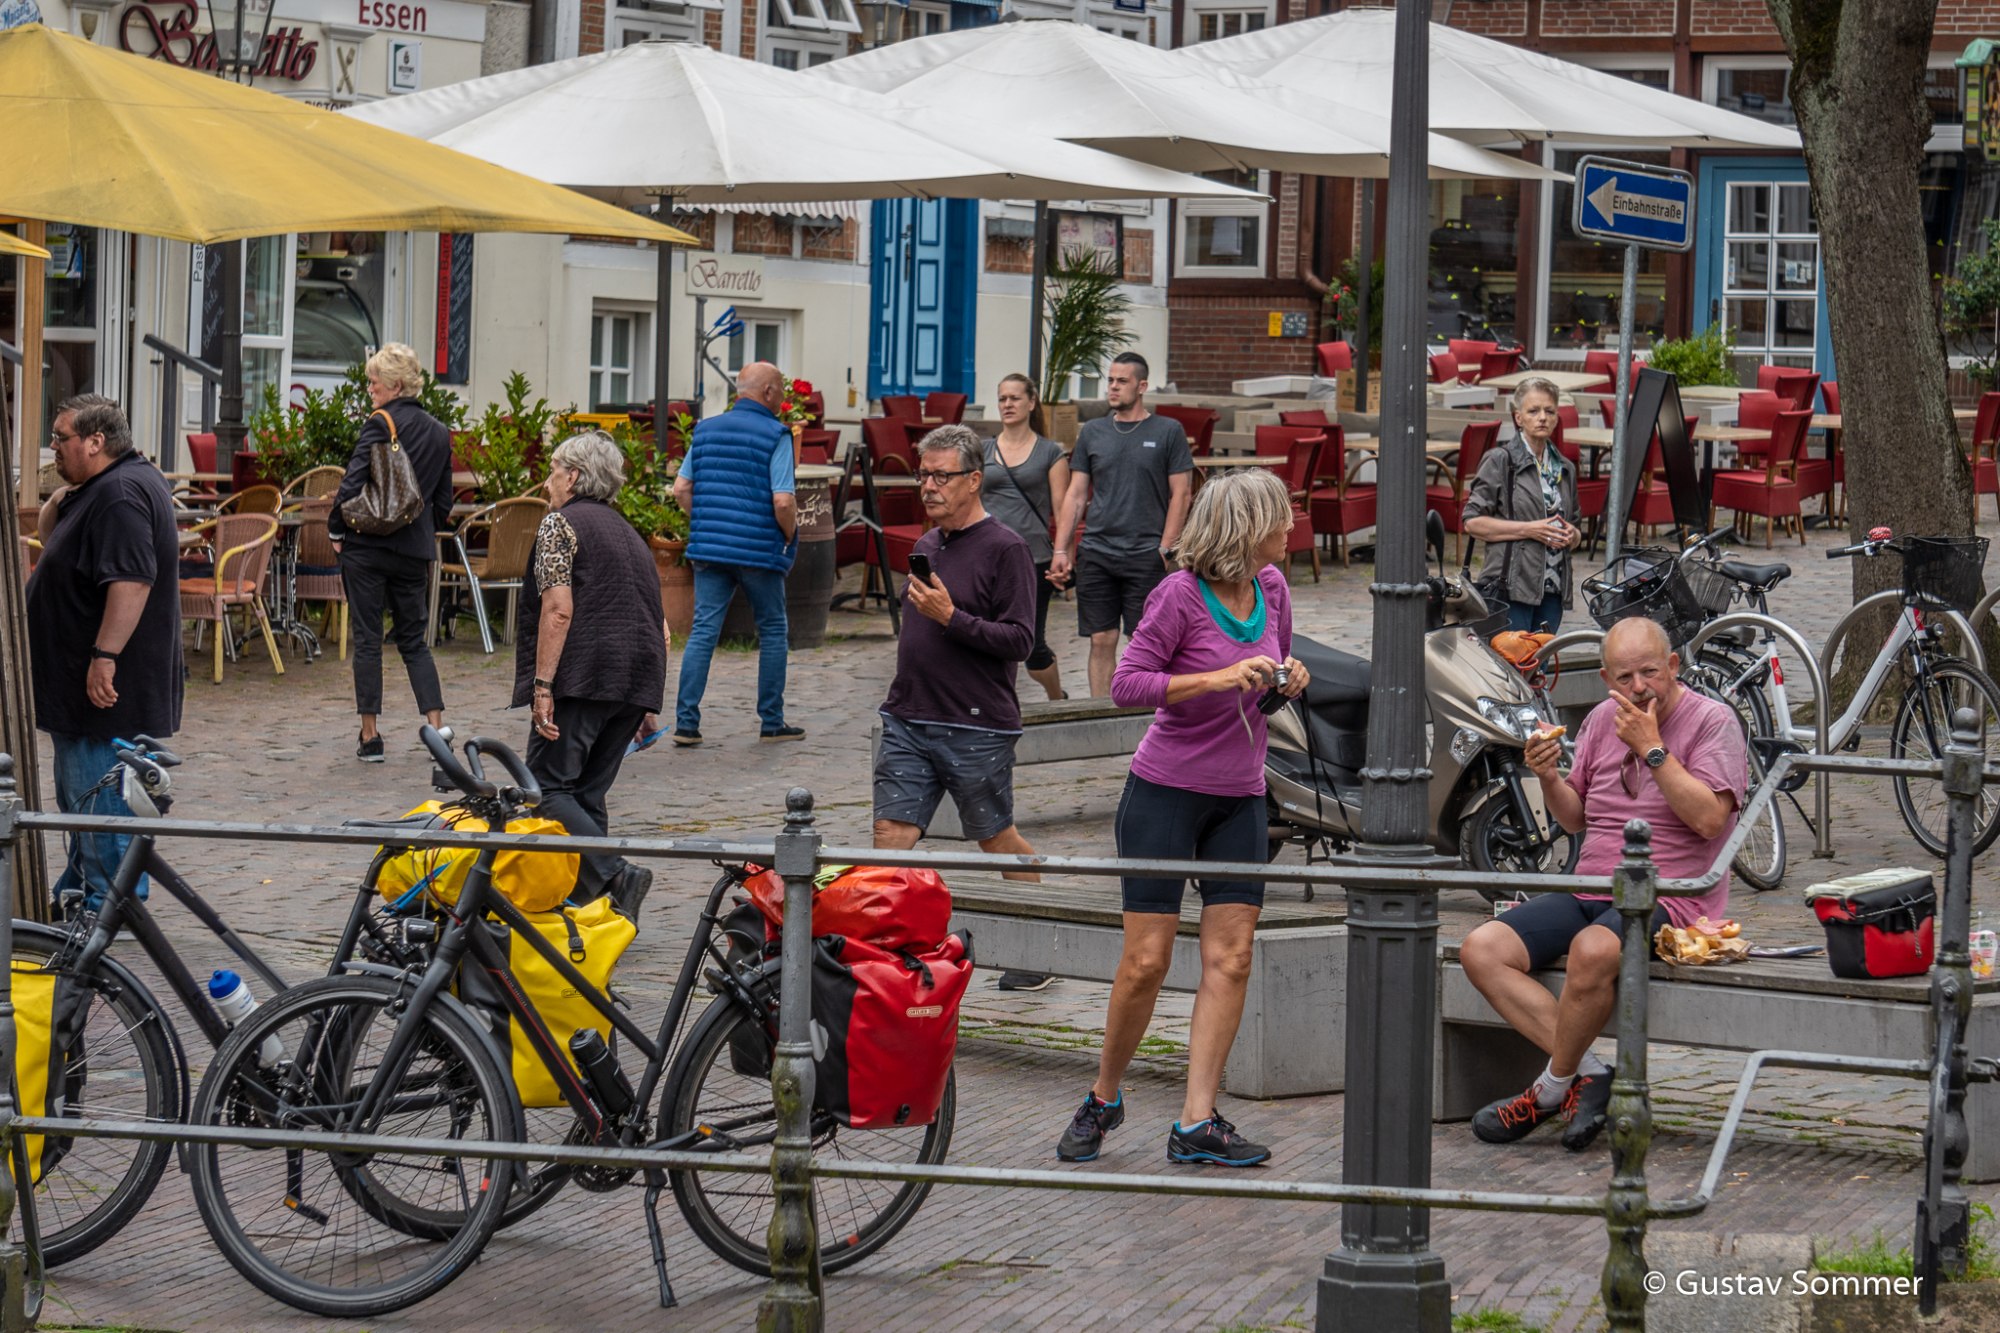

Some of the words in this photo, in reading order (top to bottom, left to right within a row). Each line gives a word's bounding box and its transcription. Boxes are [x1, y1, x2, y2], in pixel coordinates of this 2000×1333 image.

[359, 0, 426, 32] Essen
[1613, 195, 1682, 219] Einbahnstraße
[691, 259, 762, 291] Barretto
